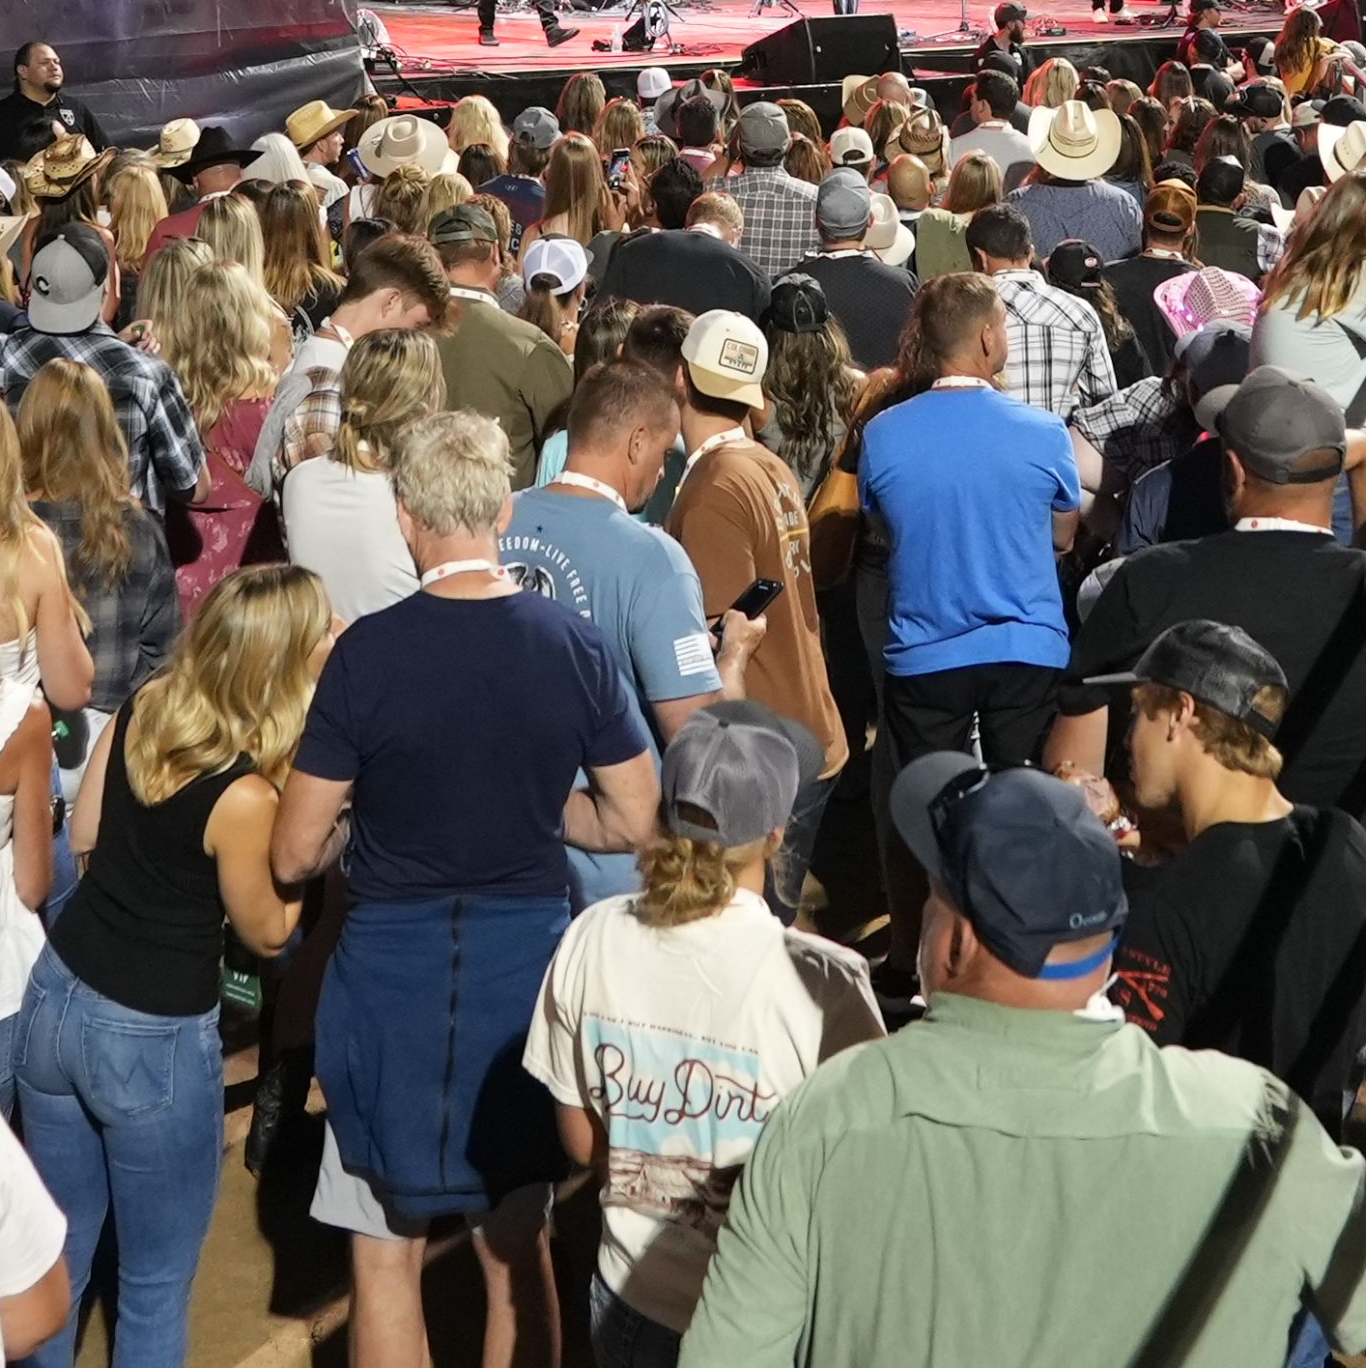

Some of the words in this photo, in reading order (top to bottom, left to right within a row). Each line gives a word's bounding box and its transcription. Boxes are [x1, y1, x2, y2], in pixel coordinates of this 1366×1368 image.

[498, 535, 571, 572] EEDOM-LIVE
[566, 569, 588, 605] FREE
[589, 1042, 666, 1123] Buy
[663, 1059, 776, 1126] Dirt
